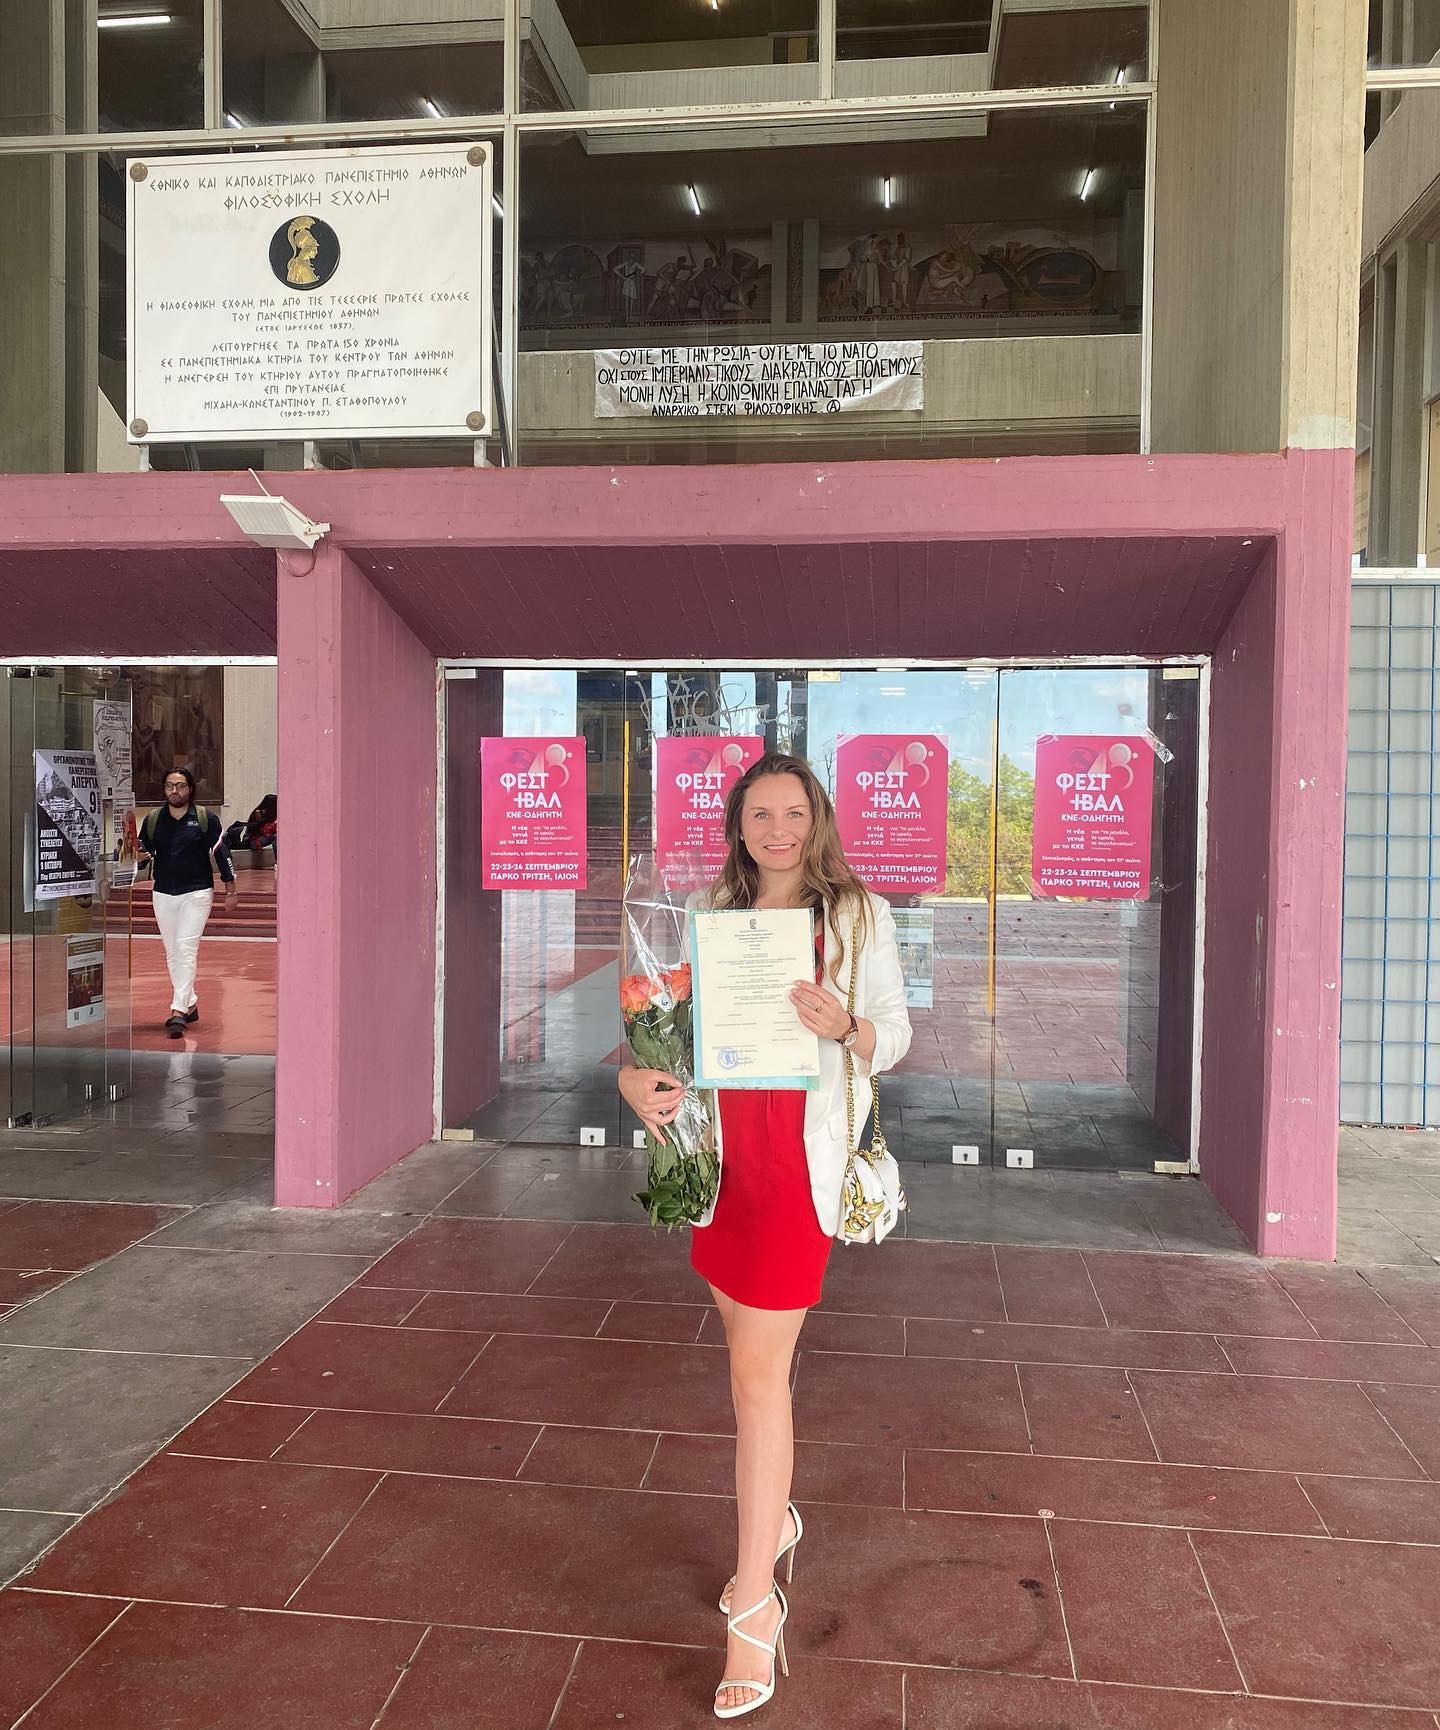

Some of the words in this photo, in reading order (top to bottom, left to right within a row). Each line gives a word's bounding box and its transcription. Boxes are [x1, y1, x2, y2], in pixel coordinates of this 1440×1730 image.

[150, 179, 190, 191] ΕΘΝΙΚΟ
[199, 177, 216, 189] ΚΑΙ
[225, 173, 315, 188] ΚΑΠΟΔΙΣΤΡΙΑΚΟ
[325, 168, 409, 184] ΠΑΝΕΠΙΣΤΗΜΙΟ
[419, 166, 467, 179] ΑΘΗΝΩΝ
[224, 192, 321, 210] ΦΙΛΟΣΟΦΙΚΗ
[331, 189, 390, 206] ΣΧΟΛΗ
[146, 302, 153, 311] Η
[160, 300, 215, 311] ΦΙΛΟΣΟΦΙΚΗ
[260, 298, 275, 307] ΜΙΑ
[282, 297, 301, 306] ΑΠΟ
[308, 296, 323, 306] ΤΙΣ
[430, 291, 470, 302] ΣΧΟΛΕΣ
[232, 313, 250, 322] ΤΟΥ
[257, 309, 333, 321] ΠΑΝΕΠΙΣΤΗΜΙΟΥ
[341, 308, 380, 318] ΑΘΗΝΩΝ
[287, 340, 299, 350] ΤΑ
[307, 339, 339, 349] ΠΡΩΤΑ
[343, 338, 359, 348] 150
[365, 337, 400, 347] ΧΡΟΝΙΑ
[161, 358, 173, 368] ΣΕ
[179, 355, 261, 367] ΠΑΝΕΠΙΣΤΗΜΙΑΚΑ
[267, 355, 302, 364] ΚΤΗΡΙΑ
[309, 353, 328, 363] ΤΟΥ
[335, 352, 380, 362] ΚΕΝΤΡΟΥ
[388, 351, 407, 361] ΤΩΝ
[414, 350, 454, 360] ΑΘΗΝΩΝ
[619, 350, 654, 365] ΟΥΤΕ
[662, 349, 679, 364] ΜΕ
[686, 347, 709, 363] ΤΗΝ
[797, 344, 815, 360] ΜΕ
[820, 343, 837, 359] ΤΟ
[843, 343, 878, 359] ΝΑΤΟ
[165, 374, 171, 384] Η
[235, 372, 254, 382] ΤΟΥ
[260, 371, 301, 381] ΚΤΗΡΙΟΥ
[309, 370, 340, 380] ΑΥΤΟΥ
[347, 367, 448, 378] ΠΡΑΓΜΑΤΟΠΟΙΗΘΗΚΕ
[598, 368, 618, 385] ΟΧΙ
[620, 370, 648, 381] ΣΤΟΥΣ
[651, 363, 755, 383] ΙΜΠΕΡΙΑΛΙΣΤΙΚΟΥΣ
[761, 360, 850, 381] ΔΙΑΚΡΑΤΙΚΟΥΣ
[855, 356, 923, 379] ΠΟΛΕΜΟΥΣ
[264, 385, 279, 395] ΕΠΙ
[285, 383, 345, 394] ΠΡΥΤΑΝΕΙΑΣ
[619, 385, 654, 403] ΜΟΝΗ
[658, 385, 690, 404] ΛΥΣΗ
[698, 384, 706, 400] Η
[711, 382, 779, 402] ΚΟΙΝΩΝΙΚΗ
[784, 379, 872, 401] ΕΠΑΝΑΣΤΑΣΗ
[651, 403, 699, 417] ΑΝΑΡΧΙΚΟ
[705, 402, 736, 416] ΣΤΕΚΙ
[71, 776, 99, 789] ΑΠΕΡΓΙΑ
[500, 773, 549, 793] ΦΕΣΤ
[675, 773, 726, 793] ΦΕΣΤ
[856, 771, 909, 792] ΦΕΣΤ
[1056, 773, 1112, 794] ΦΕΣΤ
[89, 791, 97, 814] 9
[506, 811, 562, 819] ΚΝΕ-ΟΔΗΓΗΤΗ
[861, 811, 921, 819] ΚΝΕ-ΟΔΗΓΗΤΗ
[1061, 814, 1124, 823] ΚΝΕ-ΟΔΗΓΗΤΗ
[880, 865, 938, 873] ΣΕΠΤΕΜΒΡΙΟΥ
[1080, 869, 1141, 878] ΣΕΠΤΕΜΒΡΙΟΥ
[1041, 878, 1073, 887] ΠΑΡΚΟ
[1113, 880, 1140, 889] ΙΛΙΟΝ
